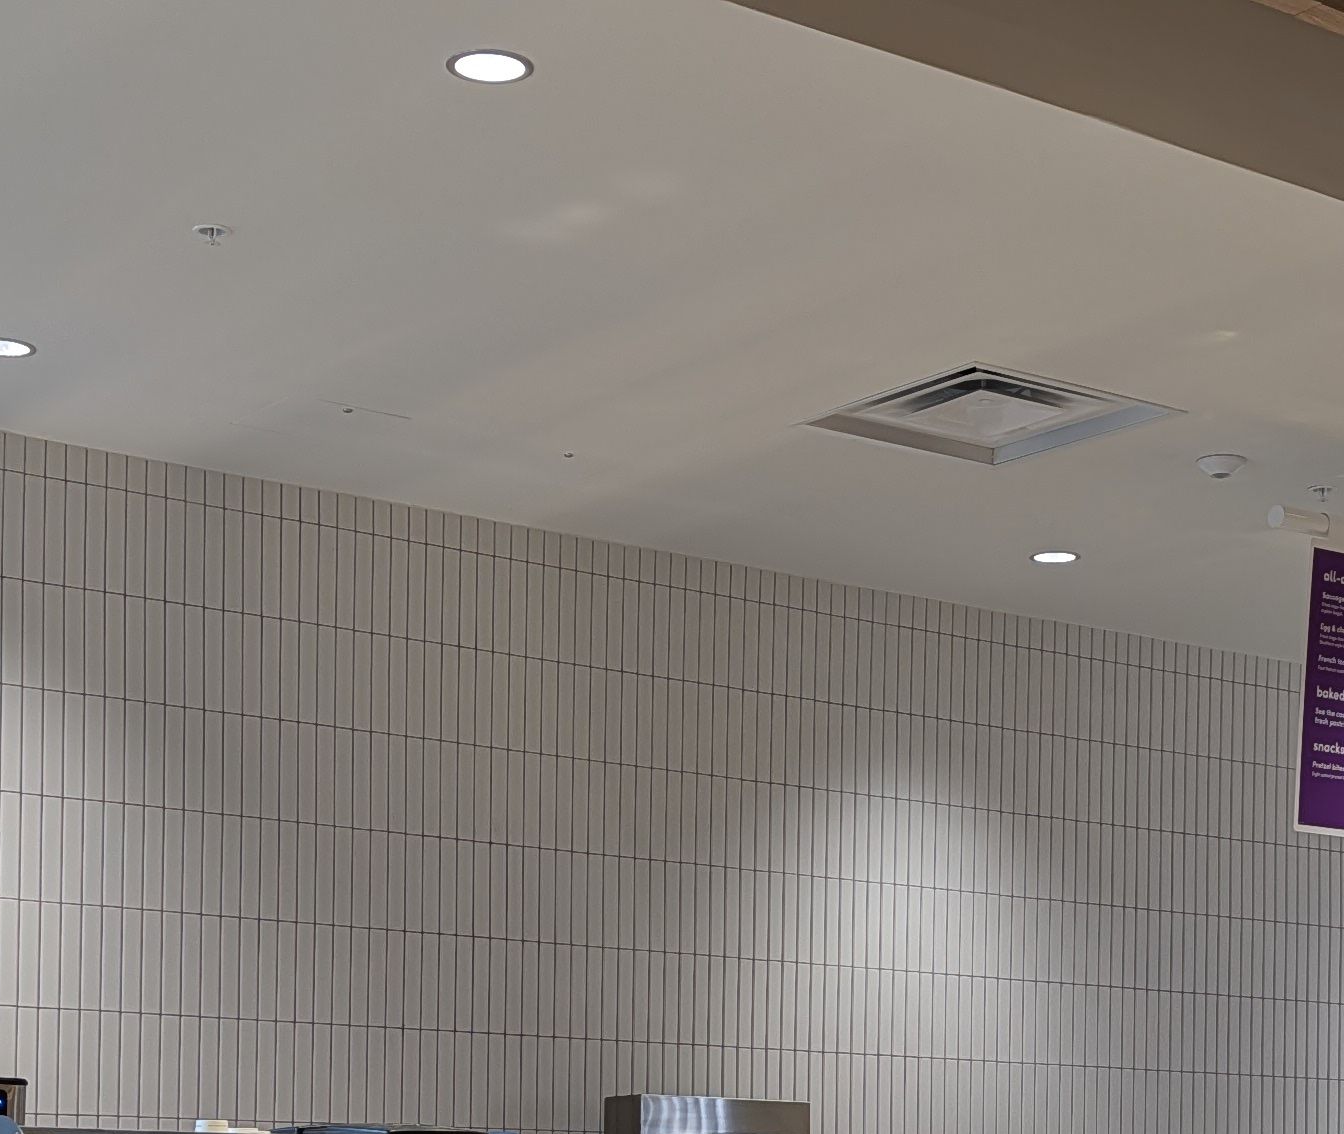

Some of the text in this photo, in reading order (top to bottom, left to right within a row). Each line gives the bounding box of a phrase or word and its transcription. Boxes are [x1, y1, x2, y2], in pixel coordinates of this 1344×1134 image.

[1320, 622, 1330, 633] Egg
[1318, 654, 1336, 664] French
[1314, 707, 1326, 716] See
[1326, 708, 1335, 717] the
[1314, 716, 1328, 726] fresh
[1312, 760, 1331, 770] Pretzel
